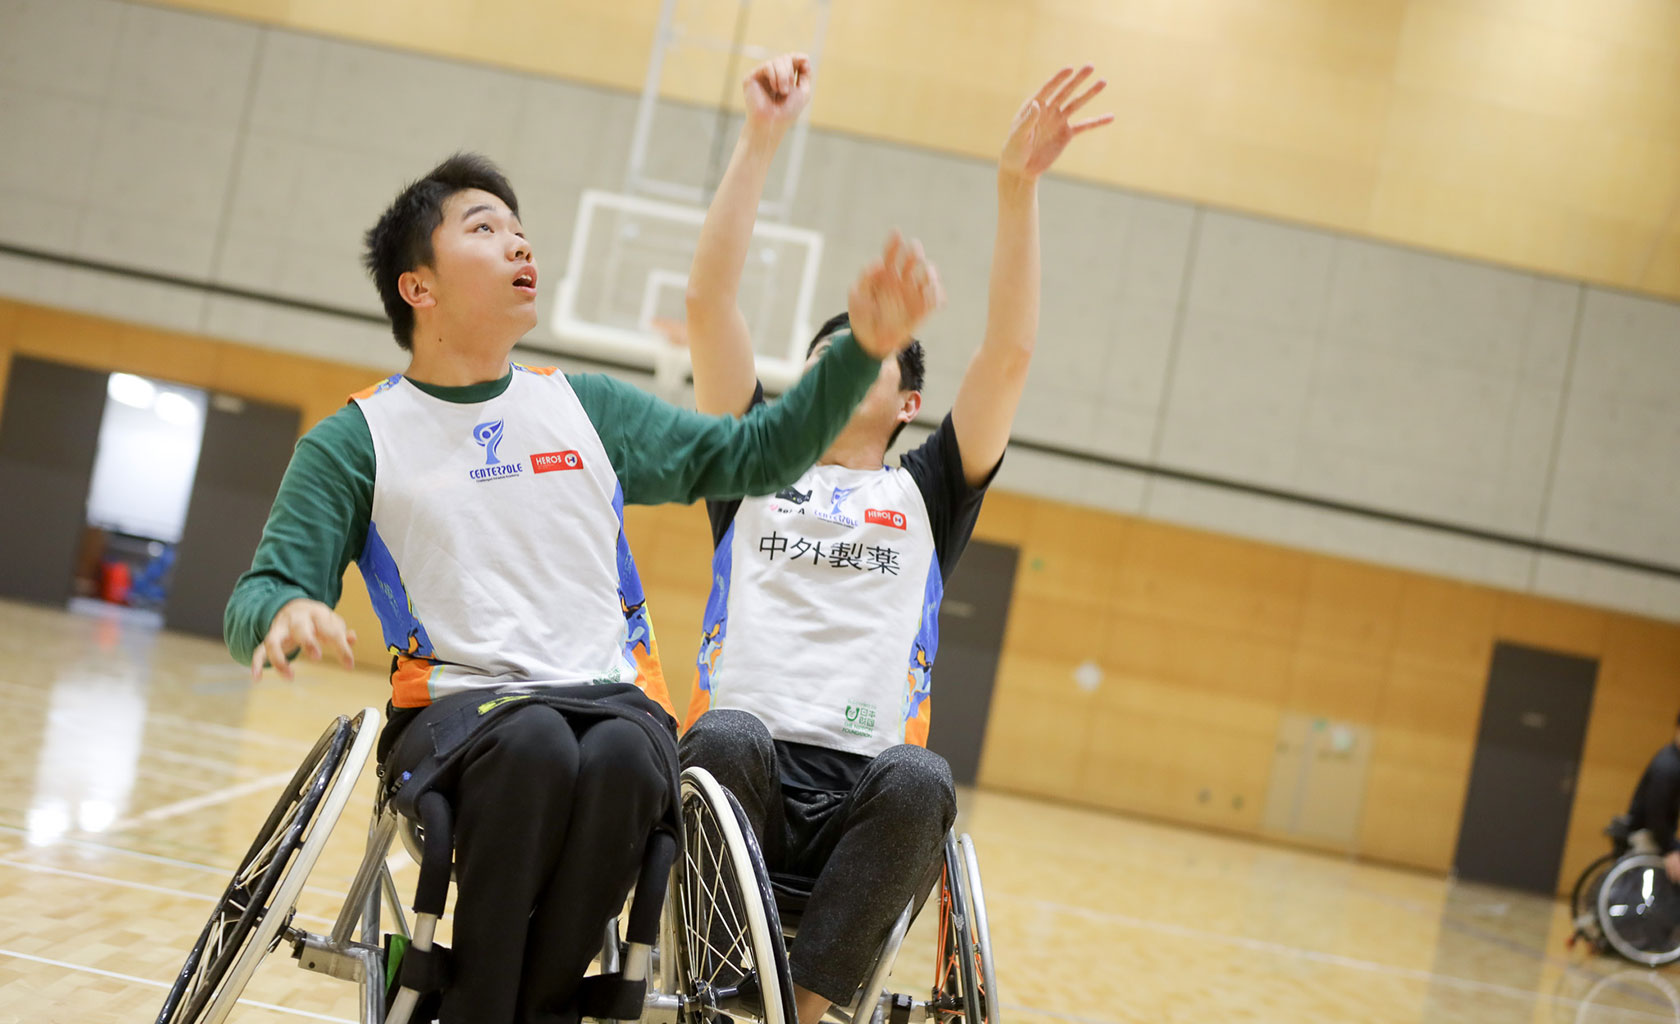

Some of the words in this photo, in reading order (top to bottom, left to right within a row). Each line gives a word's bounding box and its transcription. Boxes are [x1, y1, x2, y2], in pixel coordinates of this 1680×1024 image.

[469, 463, 523, 480] CENTERPOLE
[759, 531, 900, 576] 中外製薬
